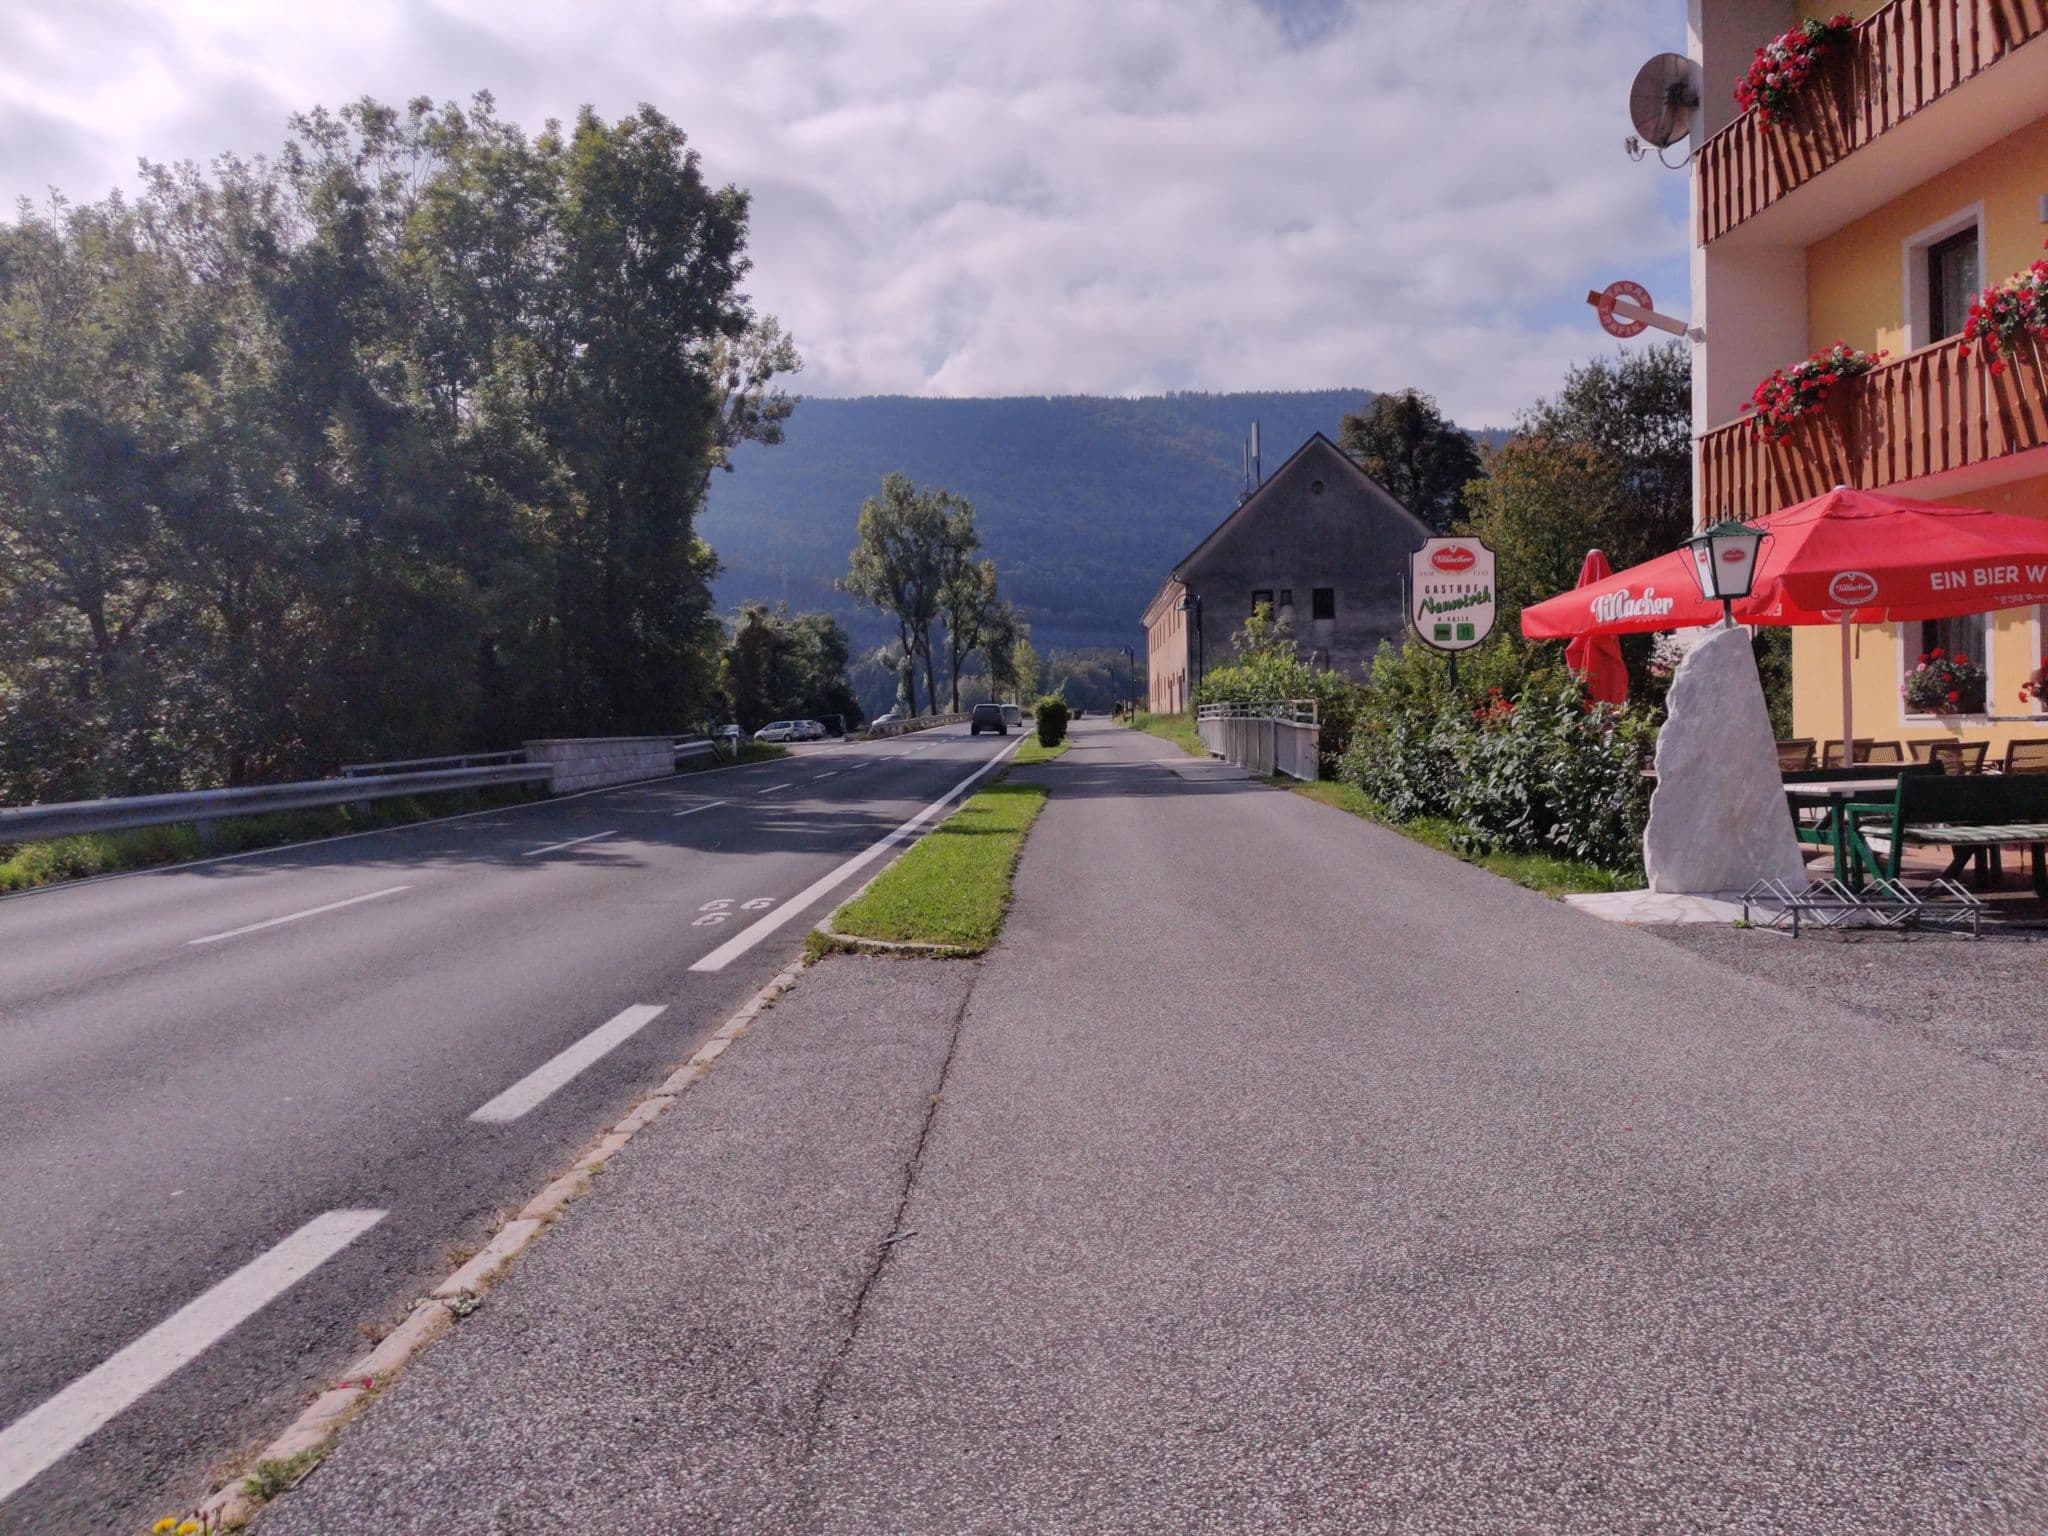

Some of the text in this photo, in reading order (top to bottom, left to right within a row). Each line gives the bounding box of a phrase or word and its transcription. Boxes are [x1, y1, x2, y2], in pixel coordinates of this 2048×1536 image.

[1605, 286, 1649, 305] TABAK
[1930, 570, 1967, 591] EIN
[1973, 565, 2020, 587] BIER
[1425, 584, 1478, 594] GASTHOF
